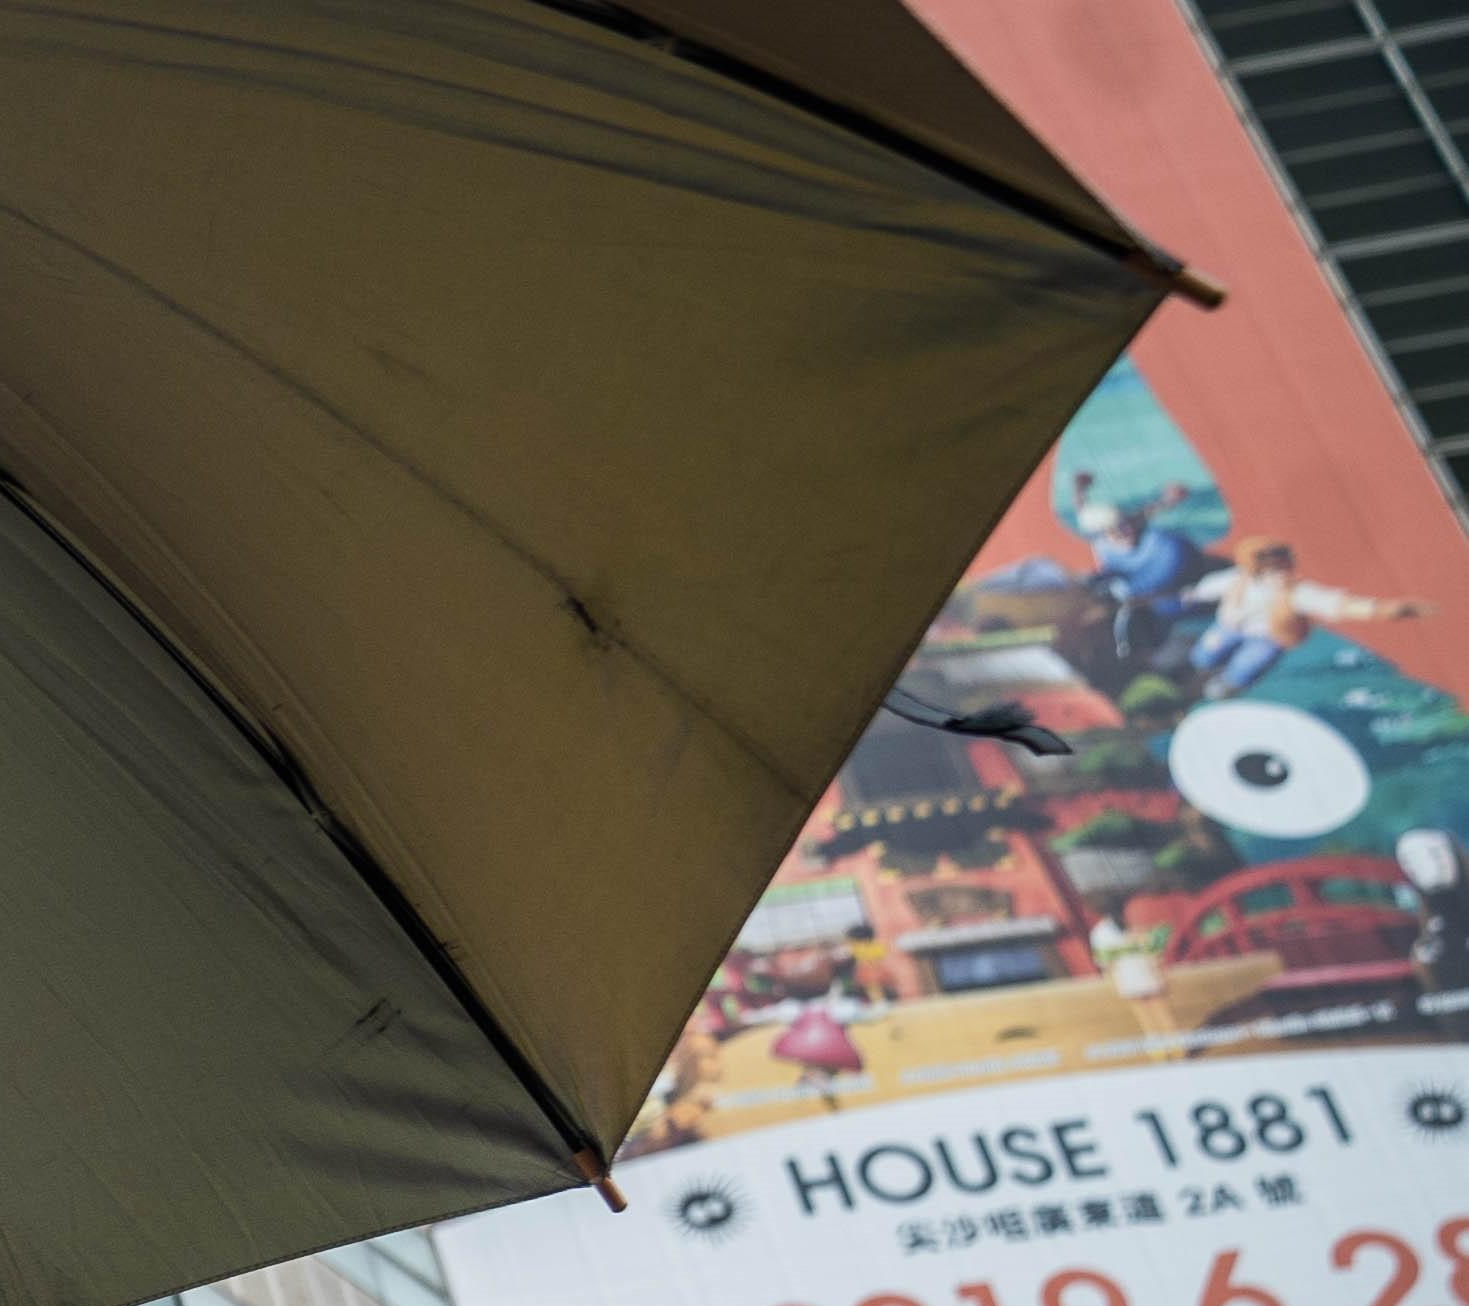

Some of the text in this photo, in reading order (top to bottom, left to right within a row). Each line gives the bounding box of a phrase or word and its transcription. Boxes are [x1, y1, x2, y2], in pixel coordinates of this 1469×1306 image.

[786, 1084, 1355, 1219] HOUSE 1881
[895, 1170, 1305, 1256] 尖沙咀廣東道 2A 號
